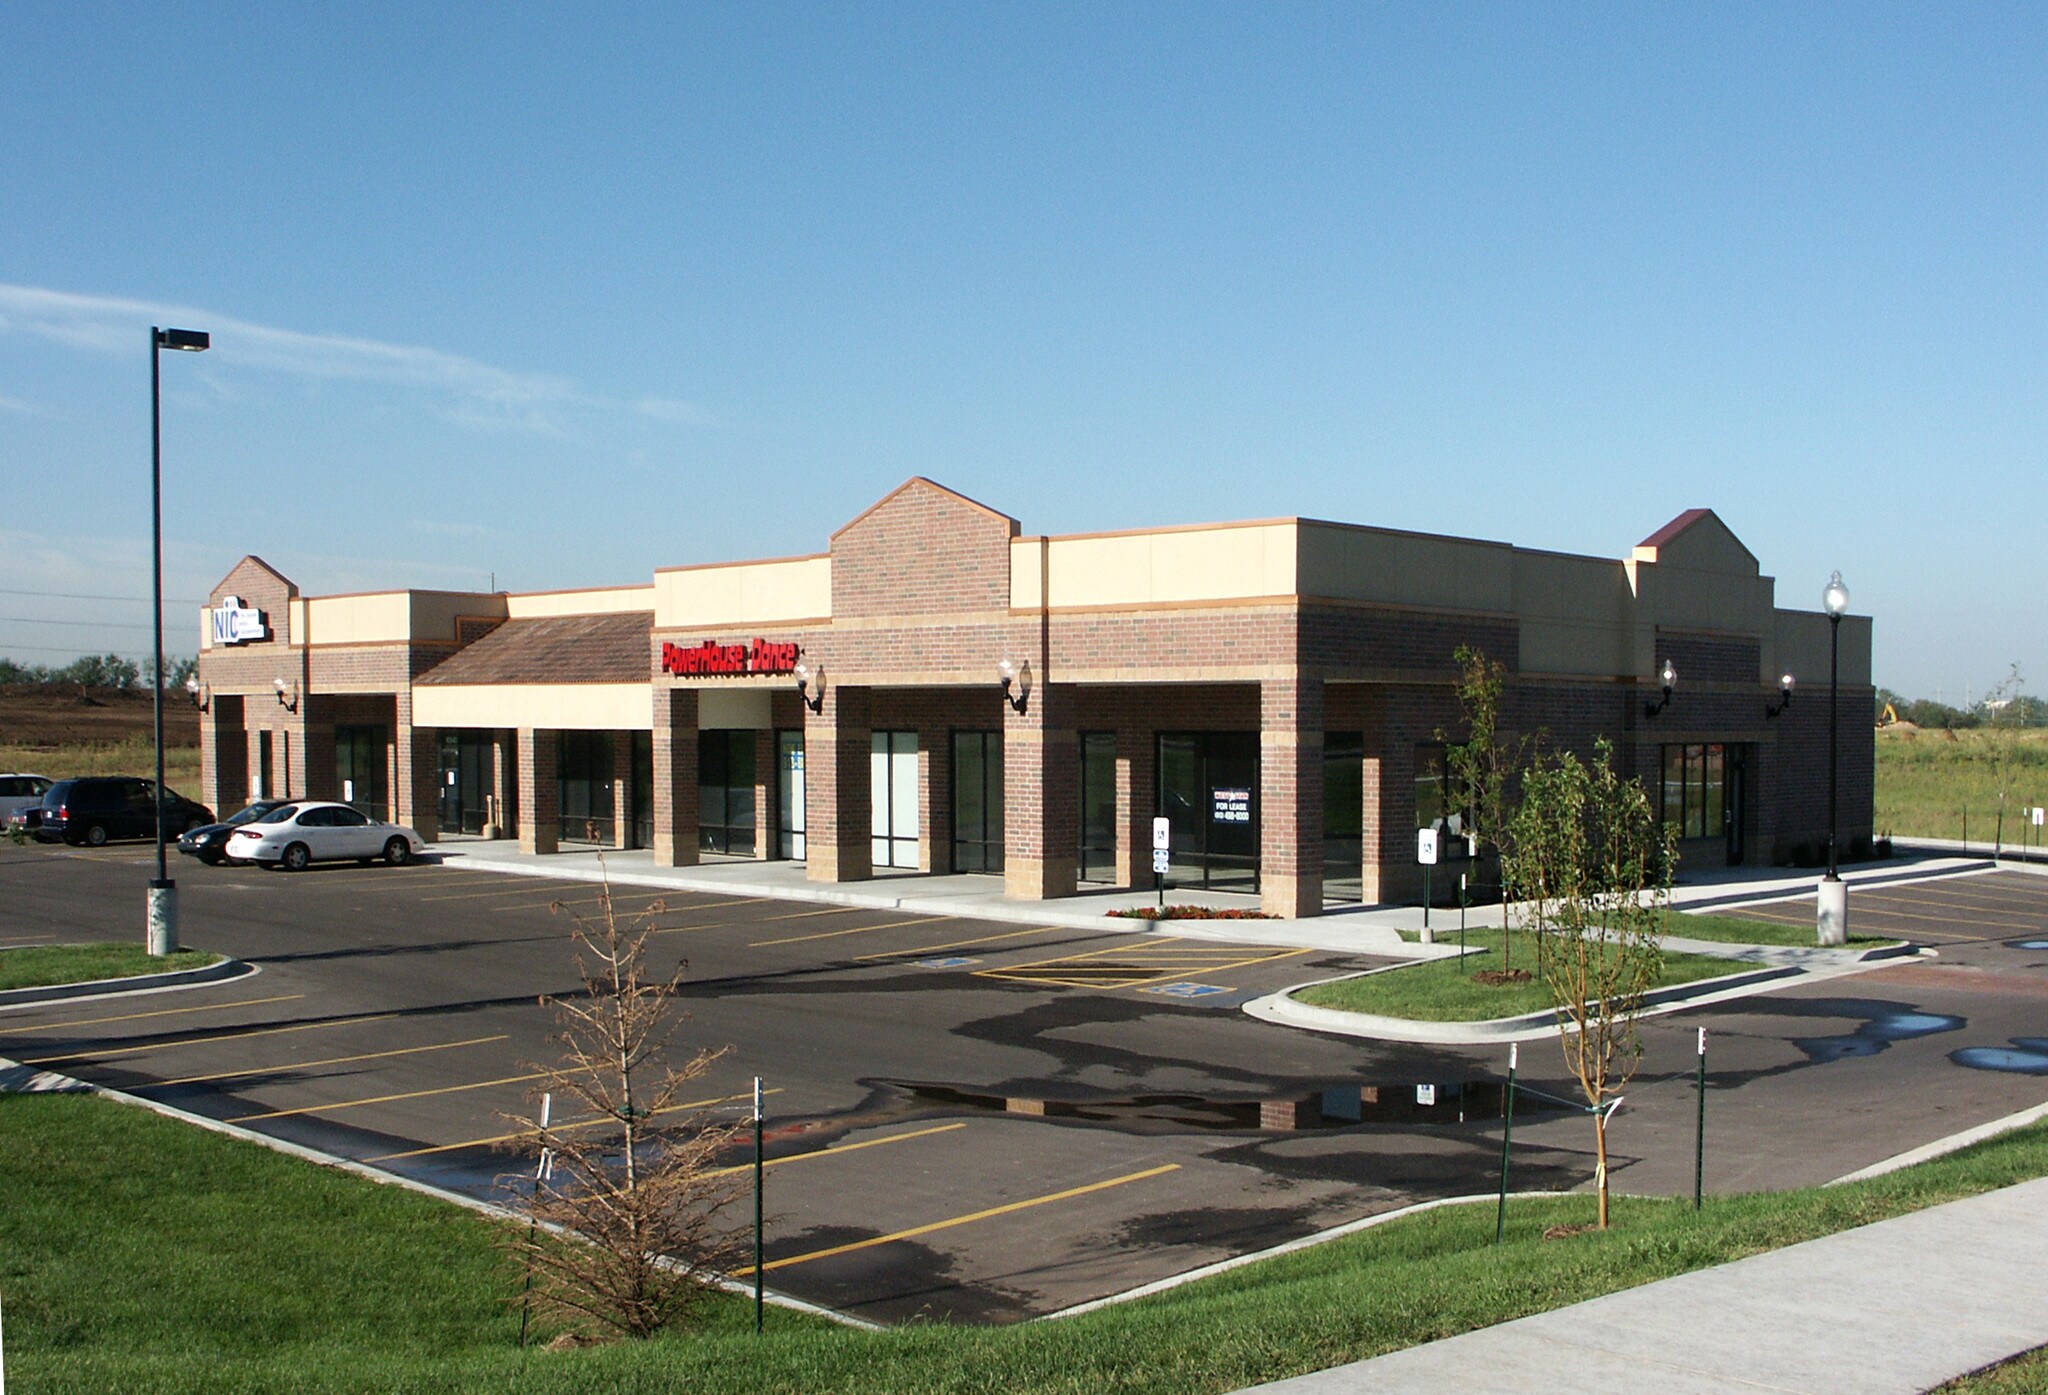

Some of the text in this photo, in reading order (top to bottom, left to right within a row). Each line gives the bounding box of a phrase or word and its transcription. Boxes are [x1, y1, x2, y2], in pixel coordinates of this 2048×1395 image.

[215, 610, 238, 639] NIC
[752, 637, 797, 671] Dance
[1216, 802, 1247, 811] FOR LEASE
